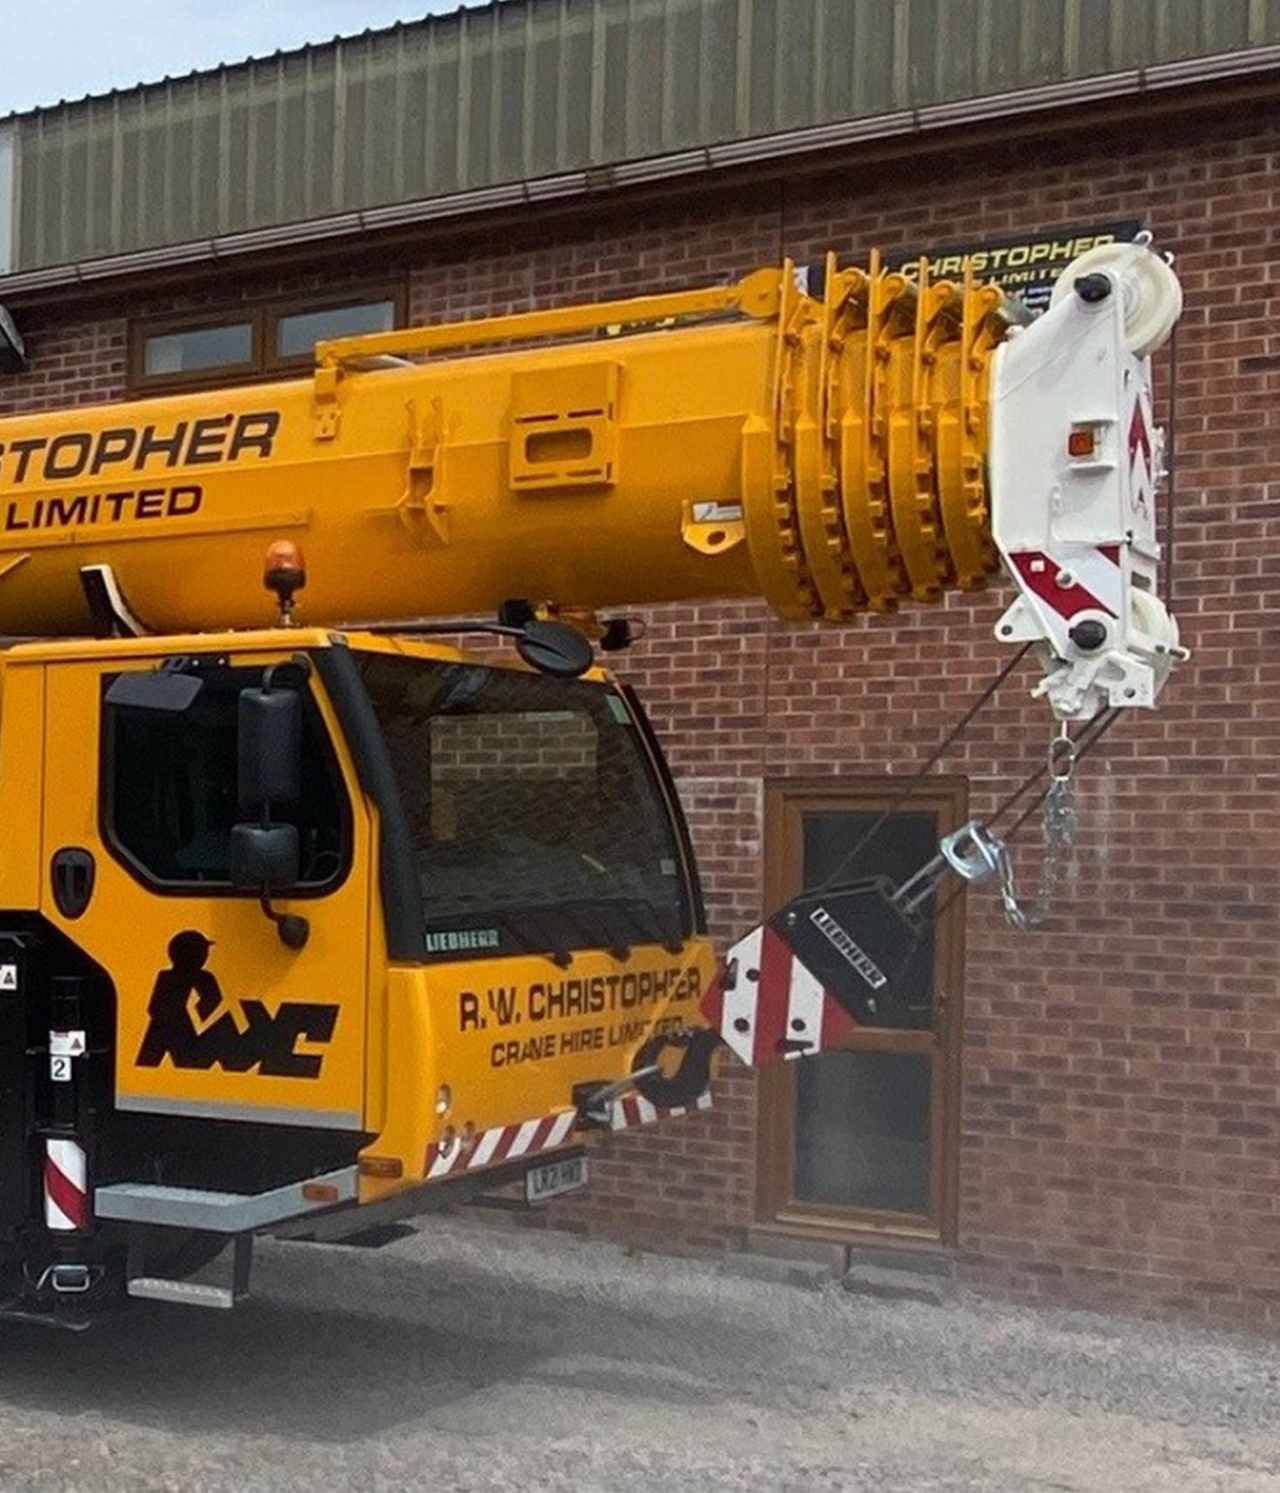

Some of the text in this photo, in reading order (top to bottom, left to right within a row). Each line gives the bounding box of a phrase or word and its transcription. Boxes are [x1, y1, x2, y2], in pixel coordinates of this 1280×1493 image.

[4, 485, 203, 531] LIMITED
[425, 929, 500, 951] LIEBHERR
[812, 909, 885, 987] LIEBHERR
[459, 967, 702, 1031] R. W. CHRISTOPHER
[53, 1058, 67, 1078] 2
[490, 1035, 556, 1068] CRANE
[560, 1026, 605, 1056] HIRE
